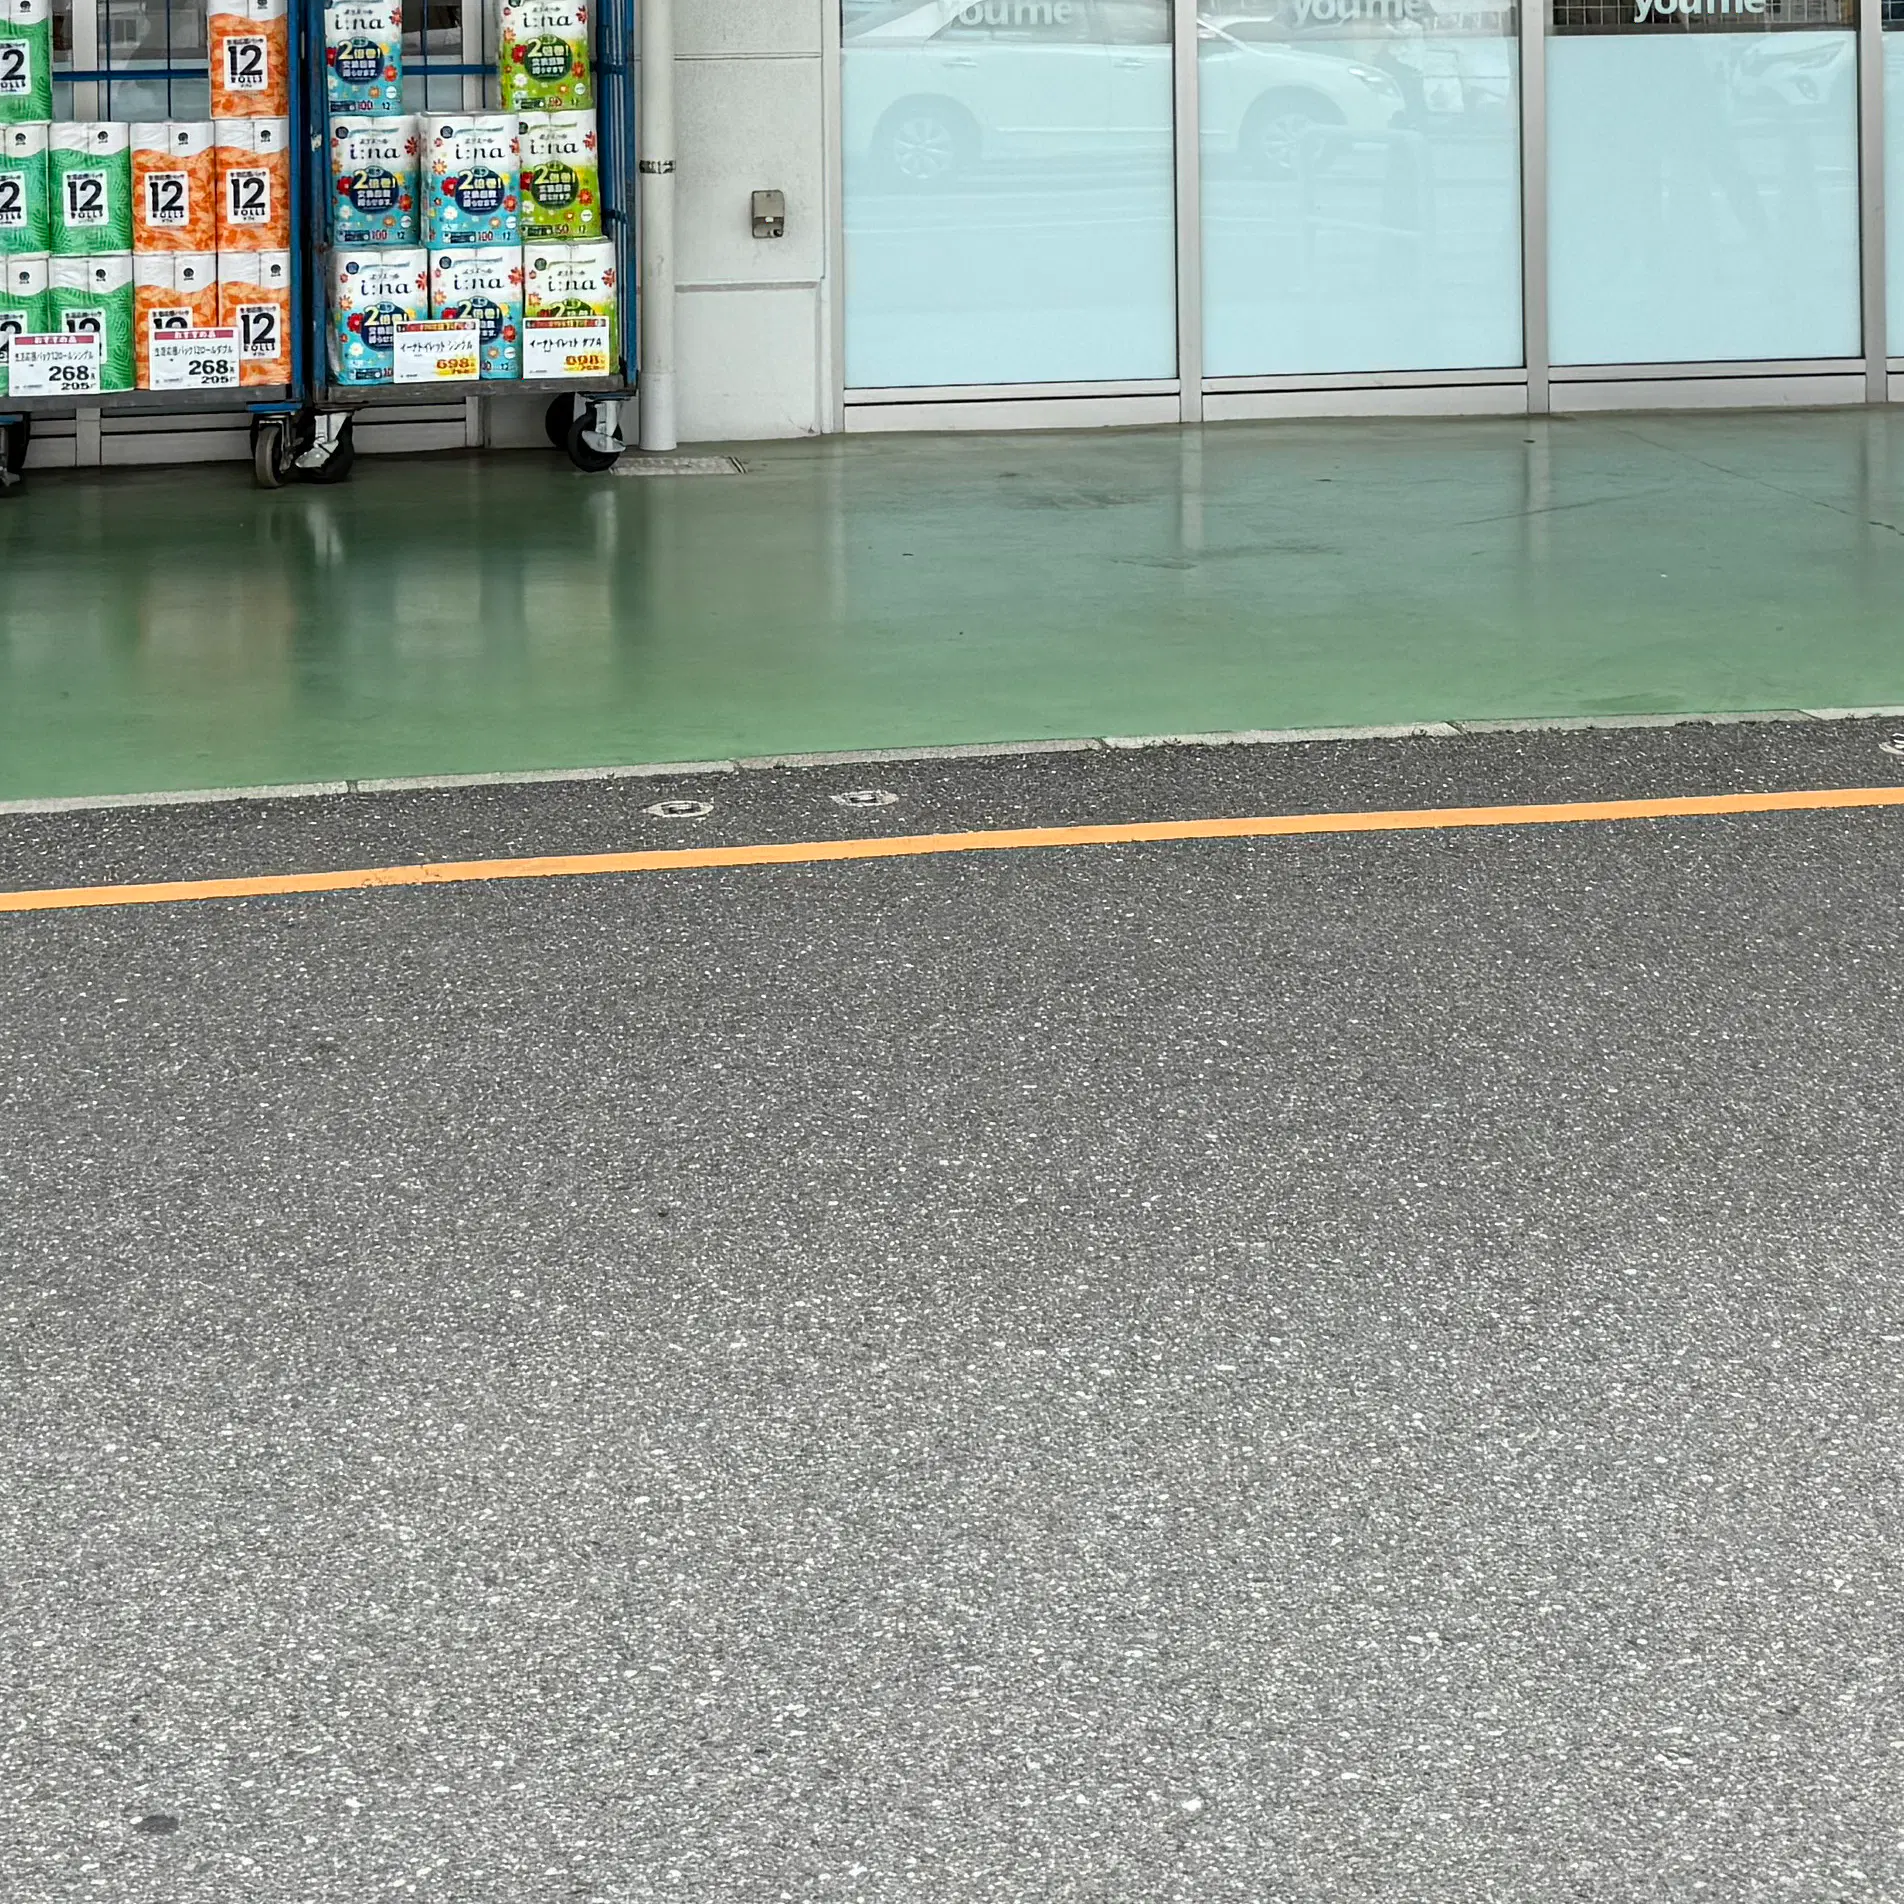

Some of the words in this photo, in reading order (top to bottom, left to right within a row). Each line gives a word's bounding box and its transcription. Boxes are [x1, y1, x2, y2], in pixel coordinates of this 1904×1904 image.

[228, 45, 264, 75] 12
[68, 180, 104, 211] 12
[149, 181, 184, 212] 12
[231, 178, 265, 208] 12
[241, 313, 276, 345] 12
[48, 365, 90, 382] 268
[188, 359, 229, 376] 268
